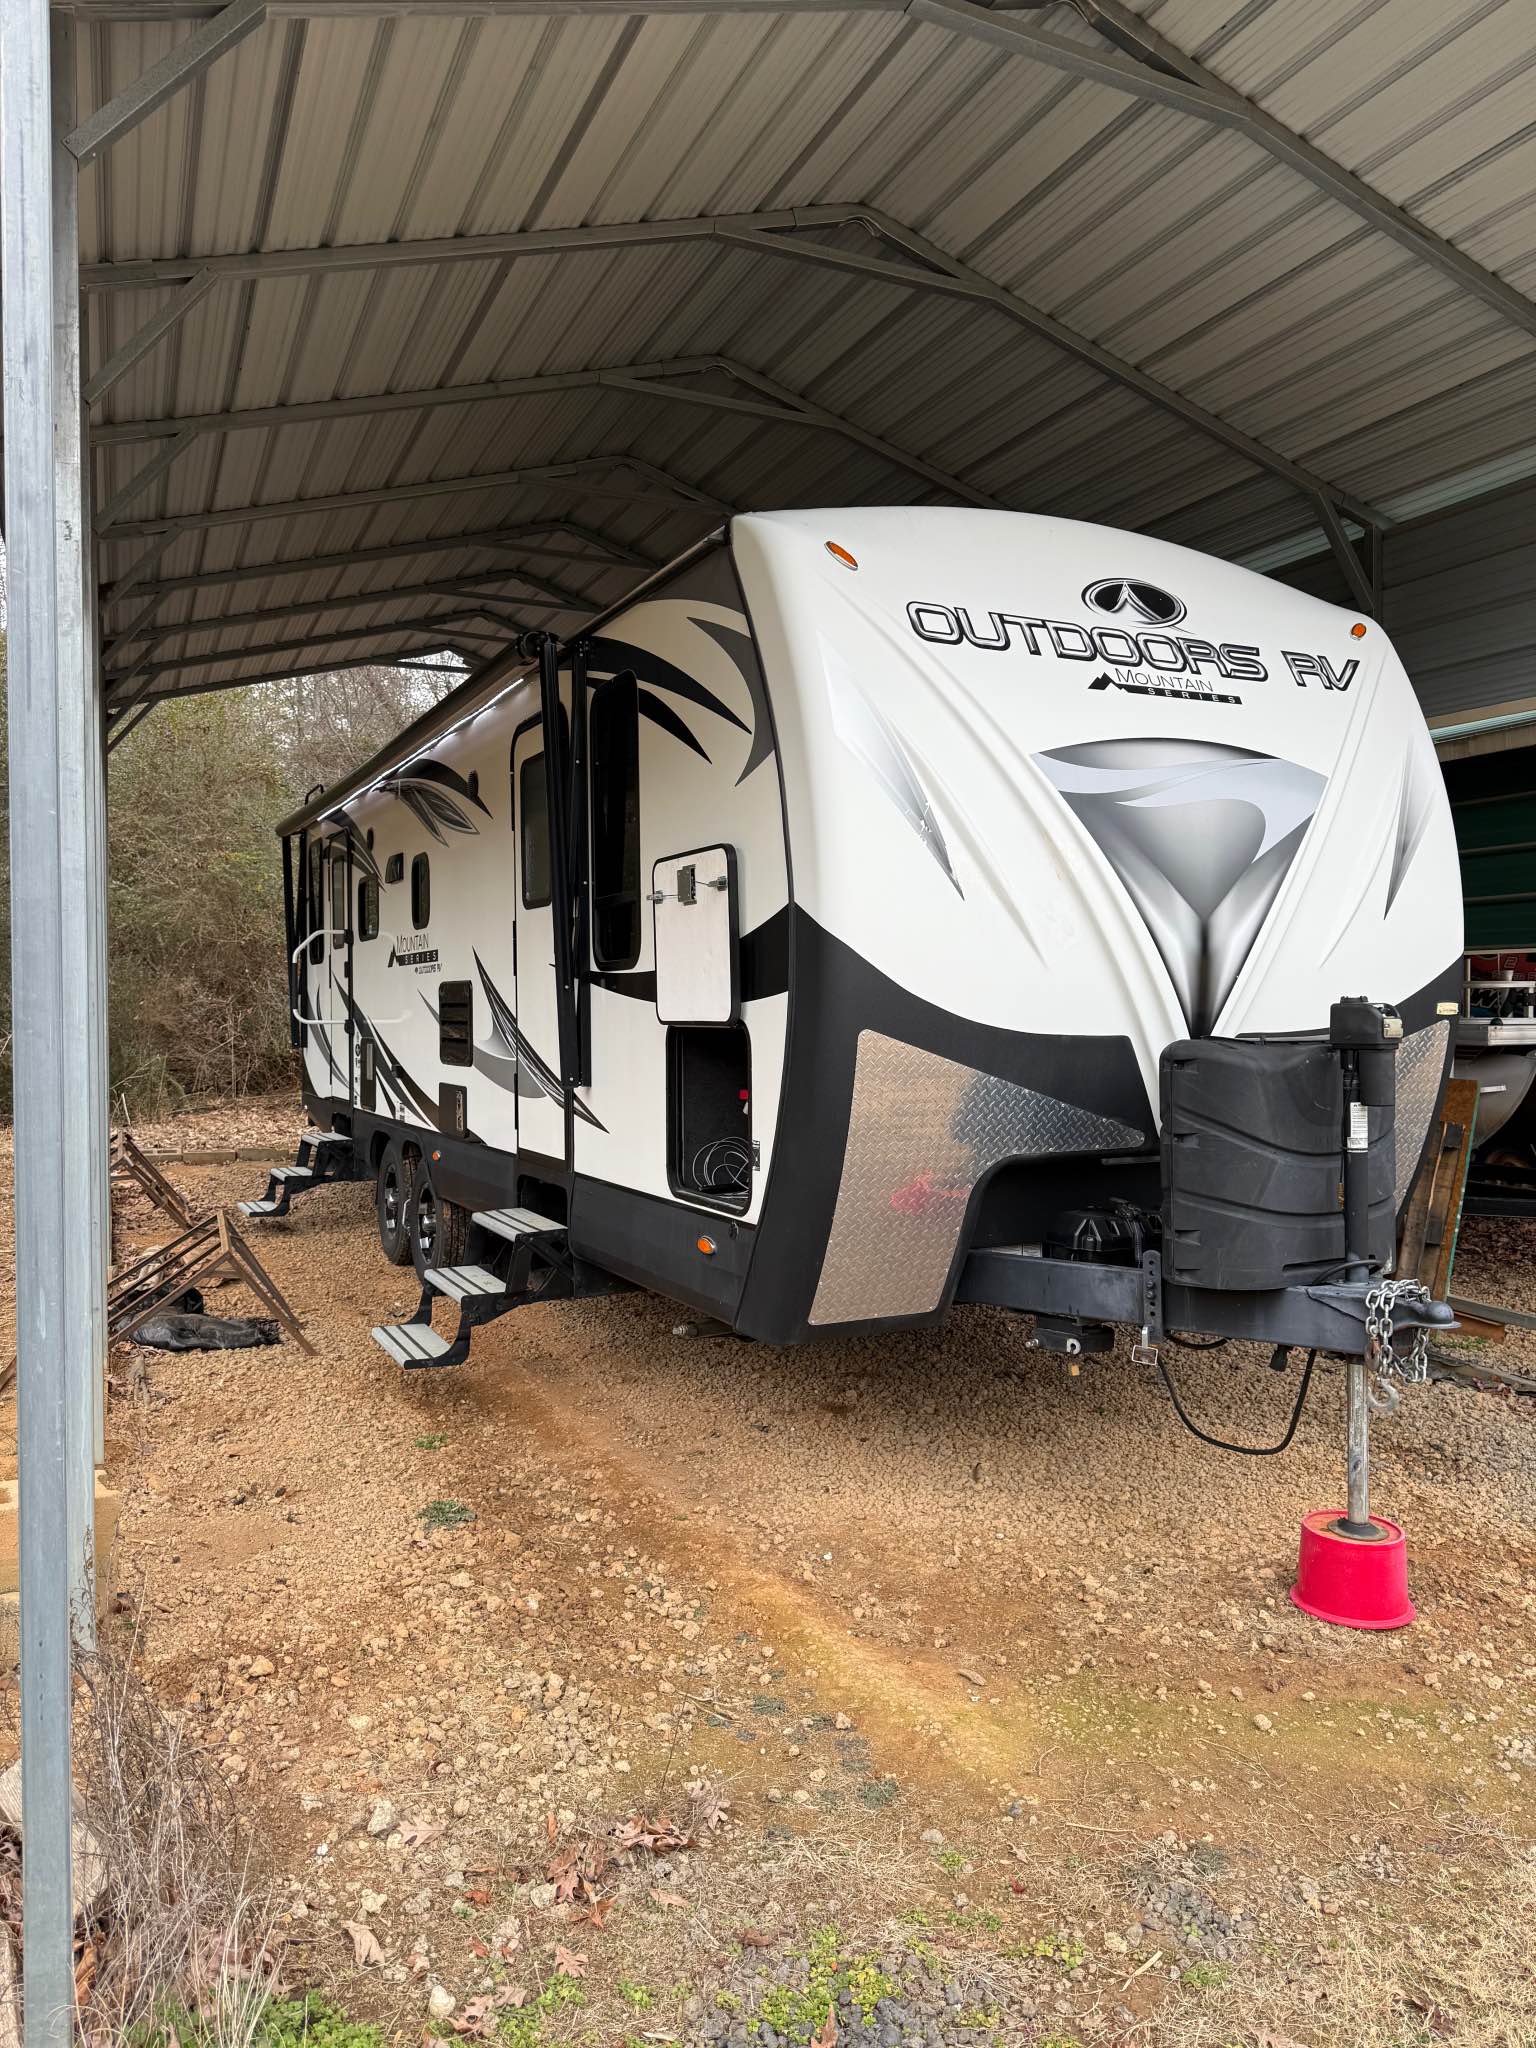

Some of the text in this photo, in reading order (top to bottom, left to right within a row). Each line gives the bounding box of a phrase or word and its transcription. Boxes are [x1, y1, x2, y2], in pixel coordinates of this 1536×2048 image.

[906, 601, 1361, 692] OUTDOORS RV
[1114, 667, 1214, 692] MOUNTAIN
[1147, 687, 1236, 704] SERIES
[397, 933, 428, 953] MOUNTAIN
[405, 952, 436, 964] SERIES
